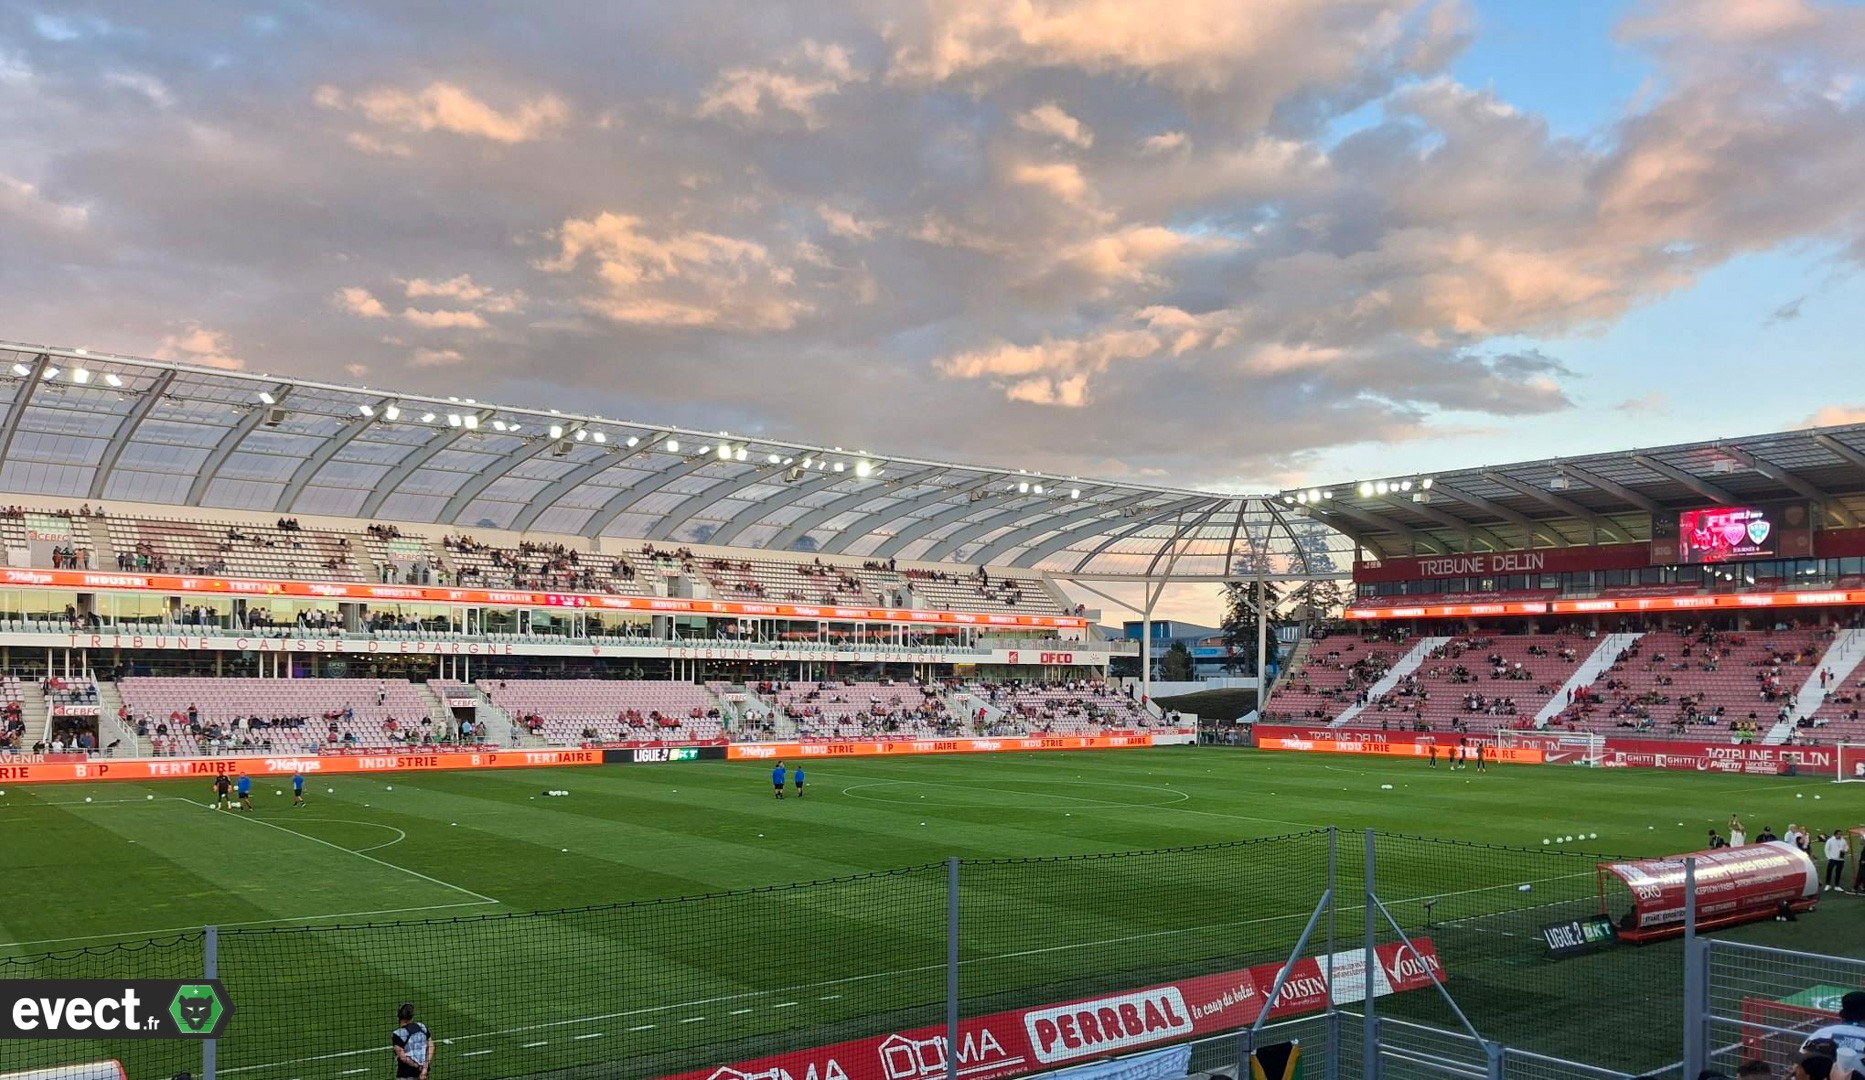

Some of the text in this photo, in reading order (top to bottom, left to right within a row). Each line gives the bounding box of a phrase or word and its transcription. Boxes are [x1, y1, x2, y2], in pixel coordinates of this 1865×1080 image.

[1418, 553, 1544, 576] TRIBUNE DELIN
[68, 634, 209, 649] TRIBUNE
[236, 637, 344, 652] CAISSE
[666, 647, 753, 660] TRIBUNE
[770, 650, 839, 662] CAISSE
[1040, 652, 1072, 663] DFCO
[801, 744, 854, 755] INDUSTRIE
[912, 742, 957, 752] TERTIAIRE
[1336, 741, 1390, 752] INDUSTRIE
[633, 749, 661, 762] LIGUE
[661, 748, 670, 761] 2
[148, 761, 236, 775] TERTIAIRE
[358, 756, 438, 769] INDUSTRIE
[525, 752, 593, 764] TERTIAIRE
[1638, 885, 1661, 900] axo
[1544, 925, 1577, 949] LIGUE
[1191, 1004, 1202, 1019] le
[1203, 998, 1223, 1015] coup
[1223, 991, 1233, 1006] de
[1034, 996, 1184, 1054] PERRBAL
